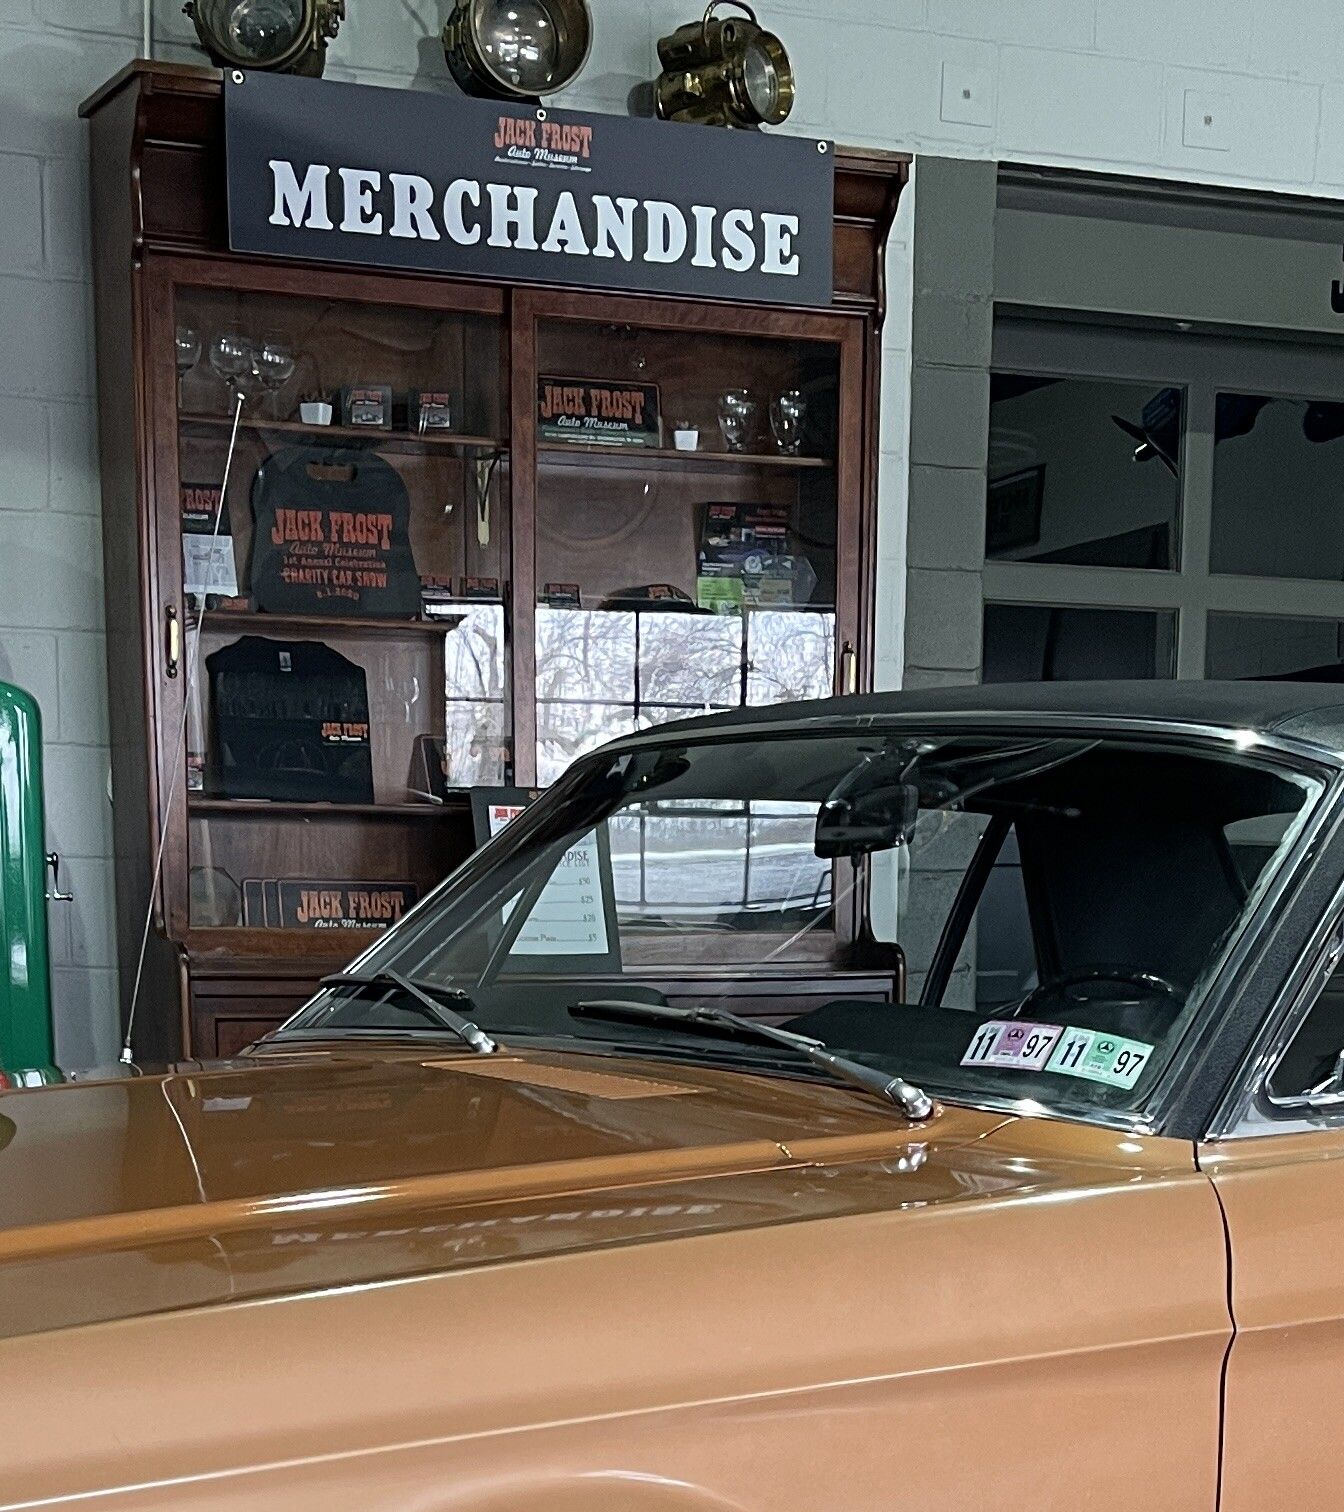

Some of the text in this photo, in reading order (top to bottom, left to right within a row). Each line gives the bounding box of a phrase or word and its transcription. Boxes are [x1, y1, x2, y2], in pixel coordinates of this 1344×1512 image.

[494, 116, 593, 158] JACK FROST
[507, 145, 578, 164] Auto Museum
[268, 160, 800, 276] MERCHANDISE
[541, 385, 644, 424] JACK FROST
[557, 415, 629, 430] Auto Museum
[184, 488, 221, 515] ROST
[271, 508, 393, 550] JACK FROST
[289, 542, 376, 558] Auto Museum
[300, 556, 333, 567] Annual
[283, 568, 388, 588] CHARITY CAR SHOW
[297, 890, 404, 923] JACK FROST
[970, 1032, 1054, 1061] 11 97
[1059, 1040, 1145, 1077] 11 97
